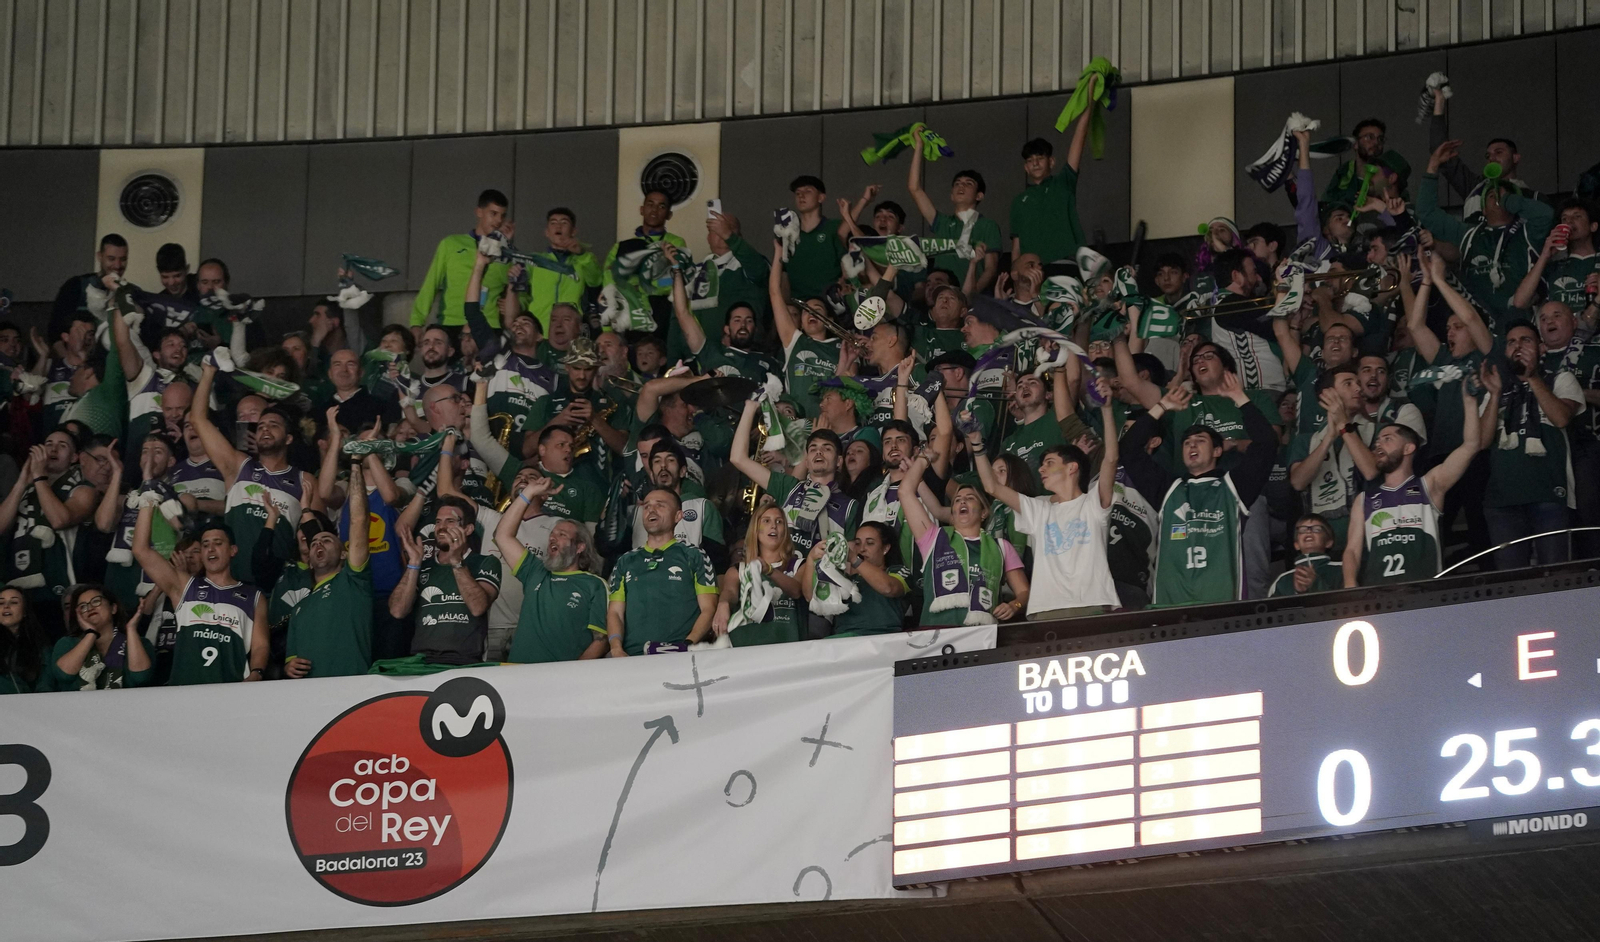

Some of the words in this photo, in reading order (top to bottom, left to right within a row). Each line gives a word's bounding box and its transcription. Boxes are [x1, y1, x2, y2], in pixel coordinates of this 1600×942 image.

[1111, 508, 1137, 528] álaga
[1186, 546, 1207, 569] 12
[1382, 553, 1406, 578] 22
[438, 612, 469, 620] MÁLAGA
[193, 628, 232, 644] málaga
[201, 646, 219, 668] 9
[1332, 620, 1381, 687] 0
[1517, 631, 1559, 682] E
[1018, 649, 1147, 692] BARÇA
[1022, 690, 1053, 714] TO
[353, 753, 410, 777] acb
[1439, 717, 1600, 803] 25.3
[328, 777, 437, 811] Copa
[1316, 748, 1373, 828] 0
[335, 811, 373, 833] del
[381, 812, 452, 847] Rey
[1508, 812, 1588, 836] MONDO
[315, 854, 399, 873] Badalona
